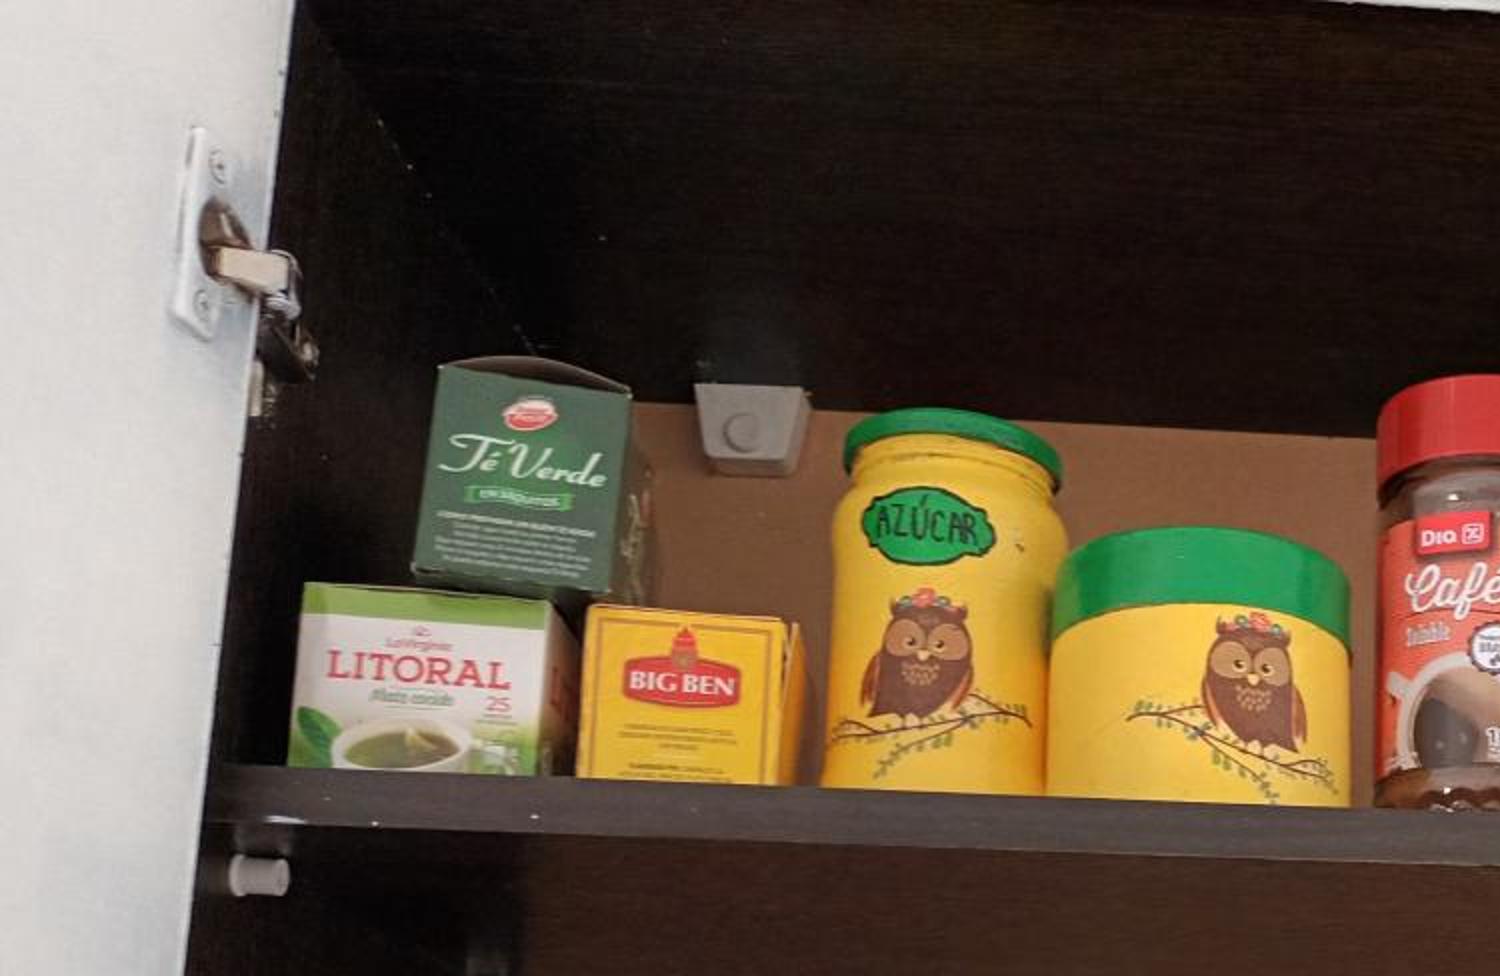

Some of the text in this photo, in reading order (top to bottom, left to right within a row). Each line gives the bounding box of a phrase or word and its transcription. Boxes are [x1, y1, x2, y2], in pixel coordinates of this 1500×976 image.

[438, 433, 608, 488] Té Verde
[876, 494, 978, 546] AZÚCAR
[327, 649, 512, 690] LITORAL
[629, 670, 737, 697] BIG BEN
